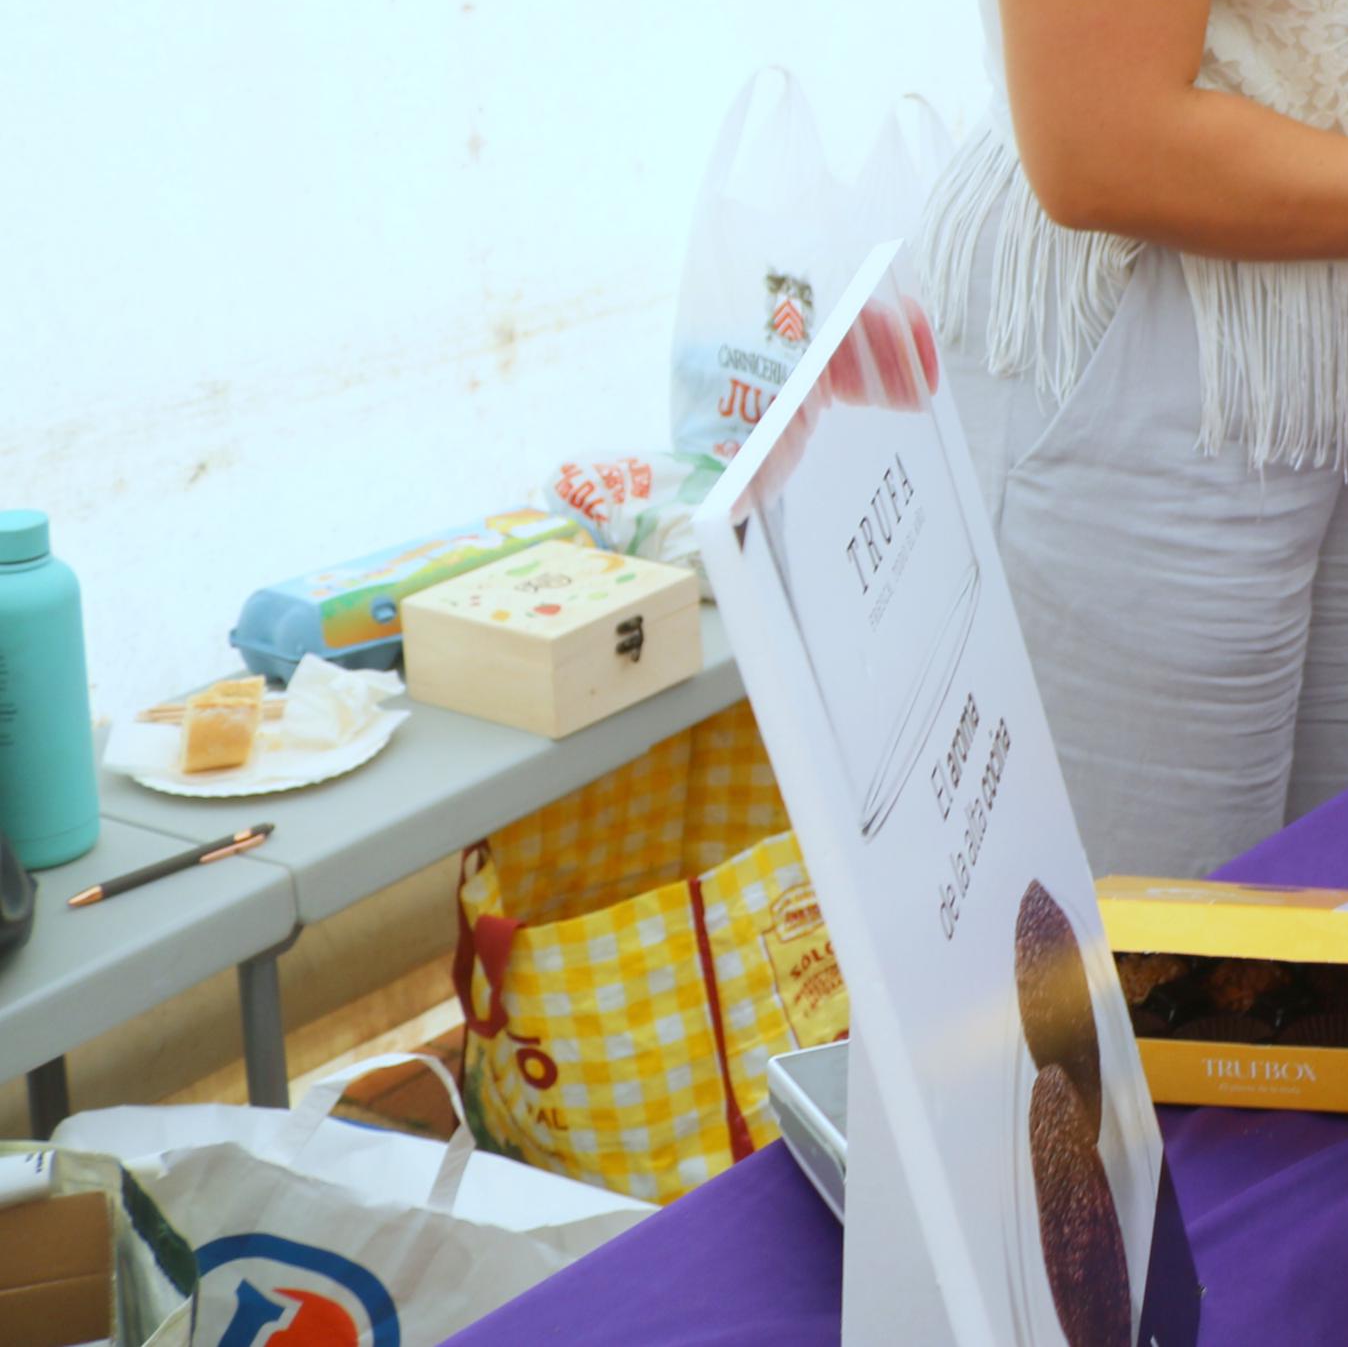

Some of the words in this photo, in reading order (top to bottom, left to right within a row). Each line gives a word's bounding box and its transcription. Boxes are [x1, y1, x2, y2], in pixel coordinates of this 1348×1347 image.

[718, 378, 775, 424] JU
[846, 451, 914, 596] TRUFA
[931, 758, 954, 823] El
[946, 692, 980, 790] aroma
[939, 883, 960, 941] de
[950, 852, 970, 900] la
[981, 716, 1011, 811] cocina
[1201, 1058, 1317, 1082] TRUFBOX
